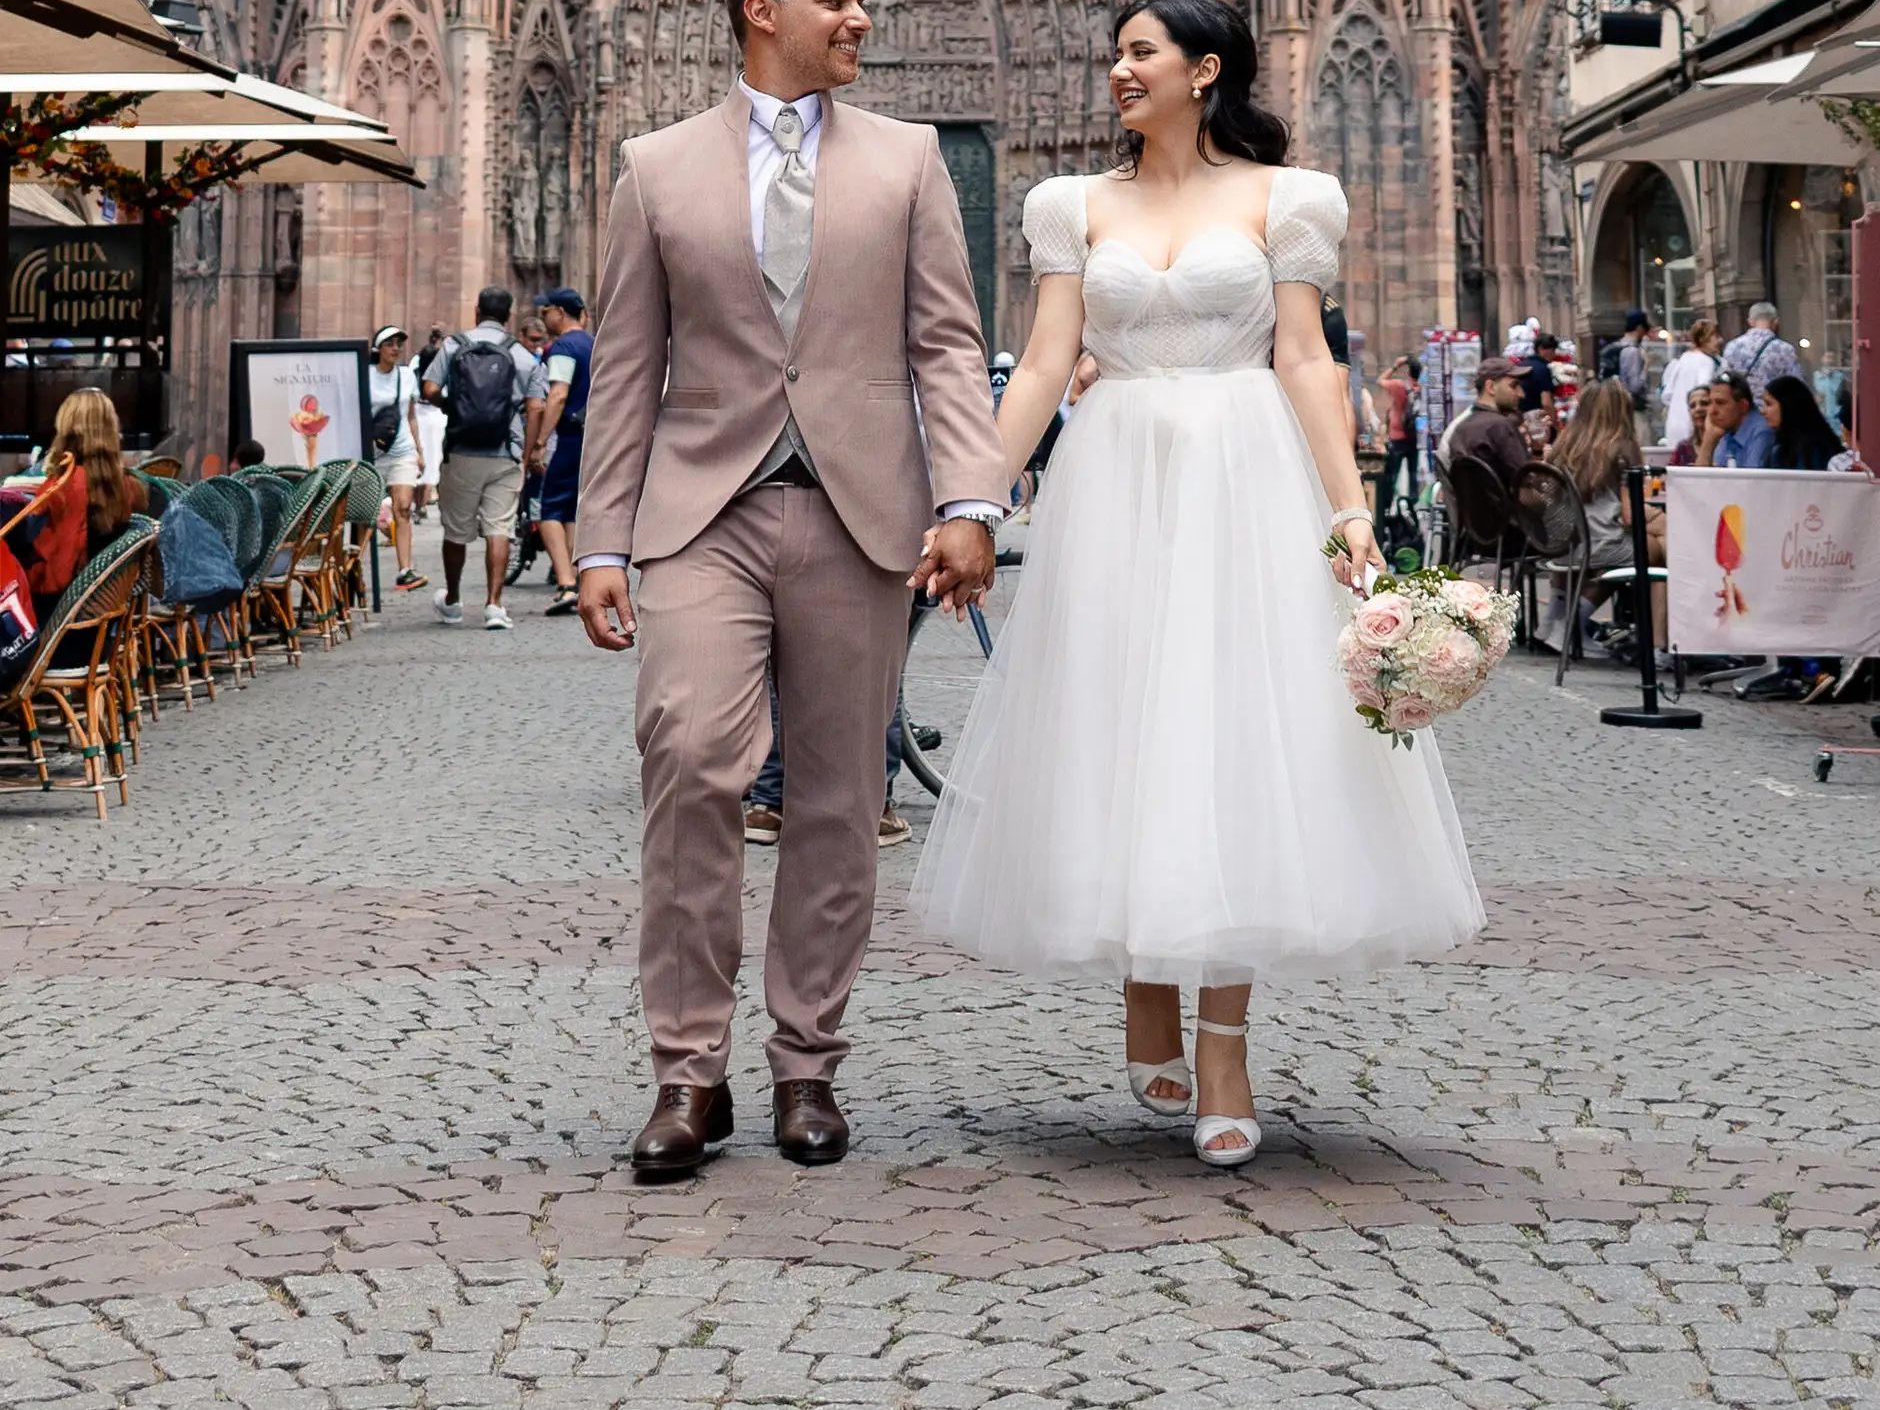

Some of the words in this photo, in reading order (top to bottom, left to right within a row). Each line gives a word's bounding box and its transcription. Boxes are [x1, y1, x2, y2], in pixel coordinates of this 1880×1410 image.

[53, 242, 108, 263] aux
[53, 264, 135, 292] douze
[53, 293, 158, 328] apôtre
[1781, 522, 1856, 571] Christian
